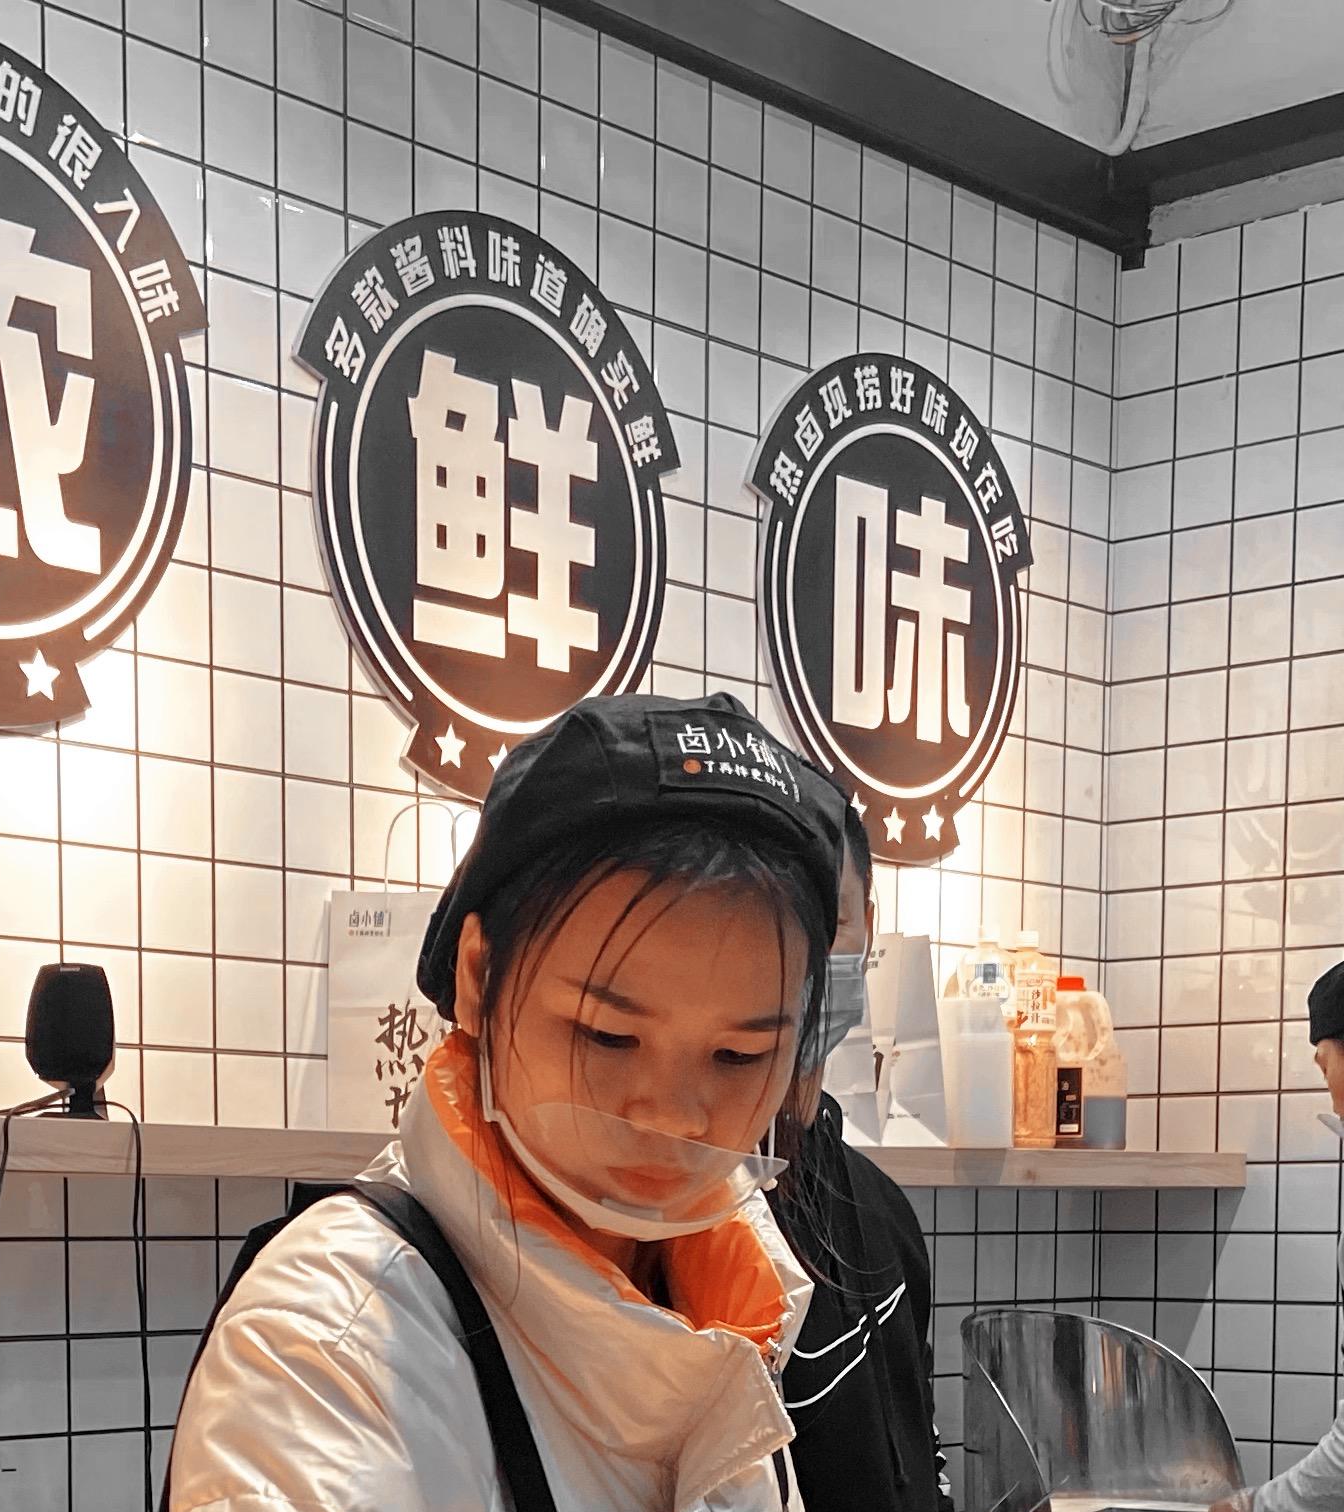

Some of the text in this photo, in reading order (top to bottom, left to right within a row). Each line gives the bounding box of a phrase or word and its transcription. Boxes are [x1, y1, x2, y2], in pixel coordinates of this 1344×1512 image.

[407, 349, 600, 673] 鲜
[769, 364, 1019, 564] 热卤现捞好味现在吃
[831, 474, 972, 744] 味
